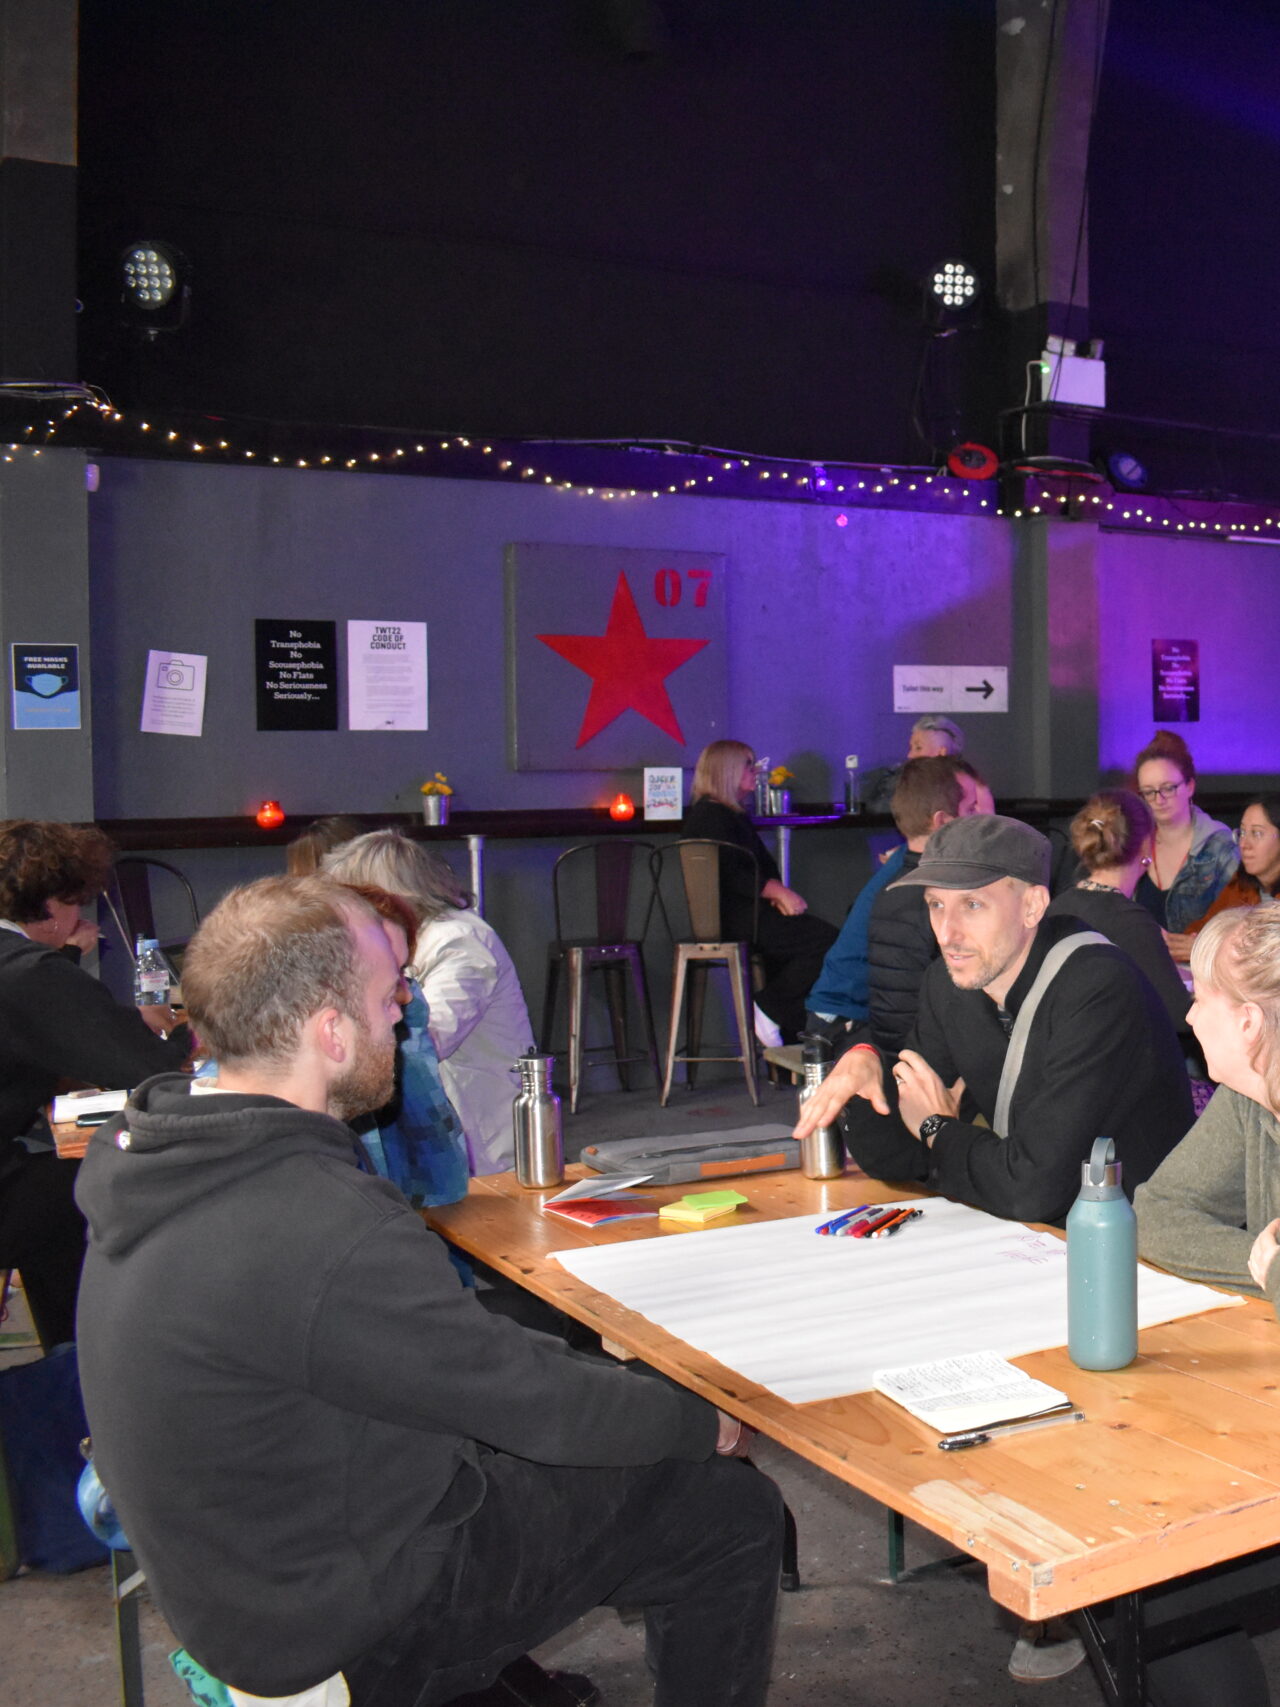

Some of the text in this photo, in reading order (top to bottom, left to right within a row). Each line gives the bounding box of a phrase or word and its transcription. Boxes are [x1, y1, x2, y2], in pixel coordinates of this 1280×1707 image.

[654, 567, 713, 608] 07
[289, 630, 302, 639] No
[375, 626, 402, 635] TWT22
[372, 634, 404, 642] CODE OF
[270, 640, 322, 650] Transphobia
[370, 642, 406, 650] CONDUCT
[289, 650, 303, 659] No
[279, 671, 292, 679] No
[265, 681, 279, 689] No
